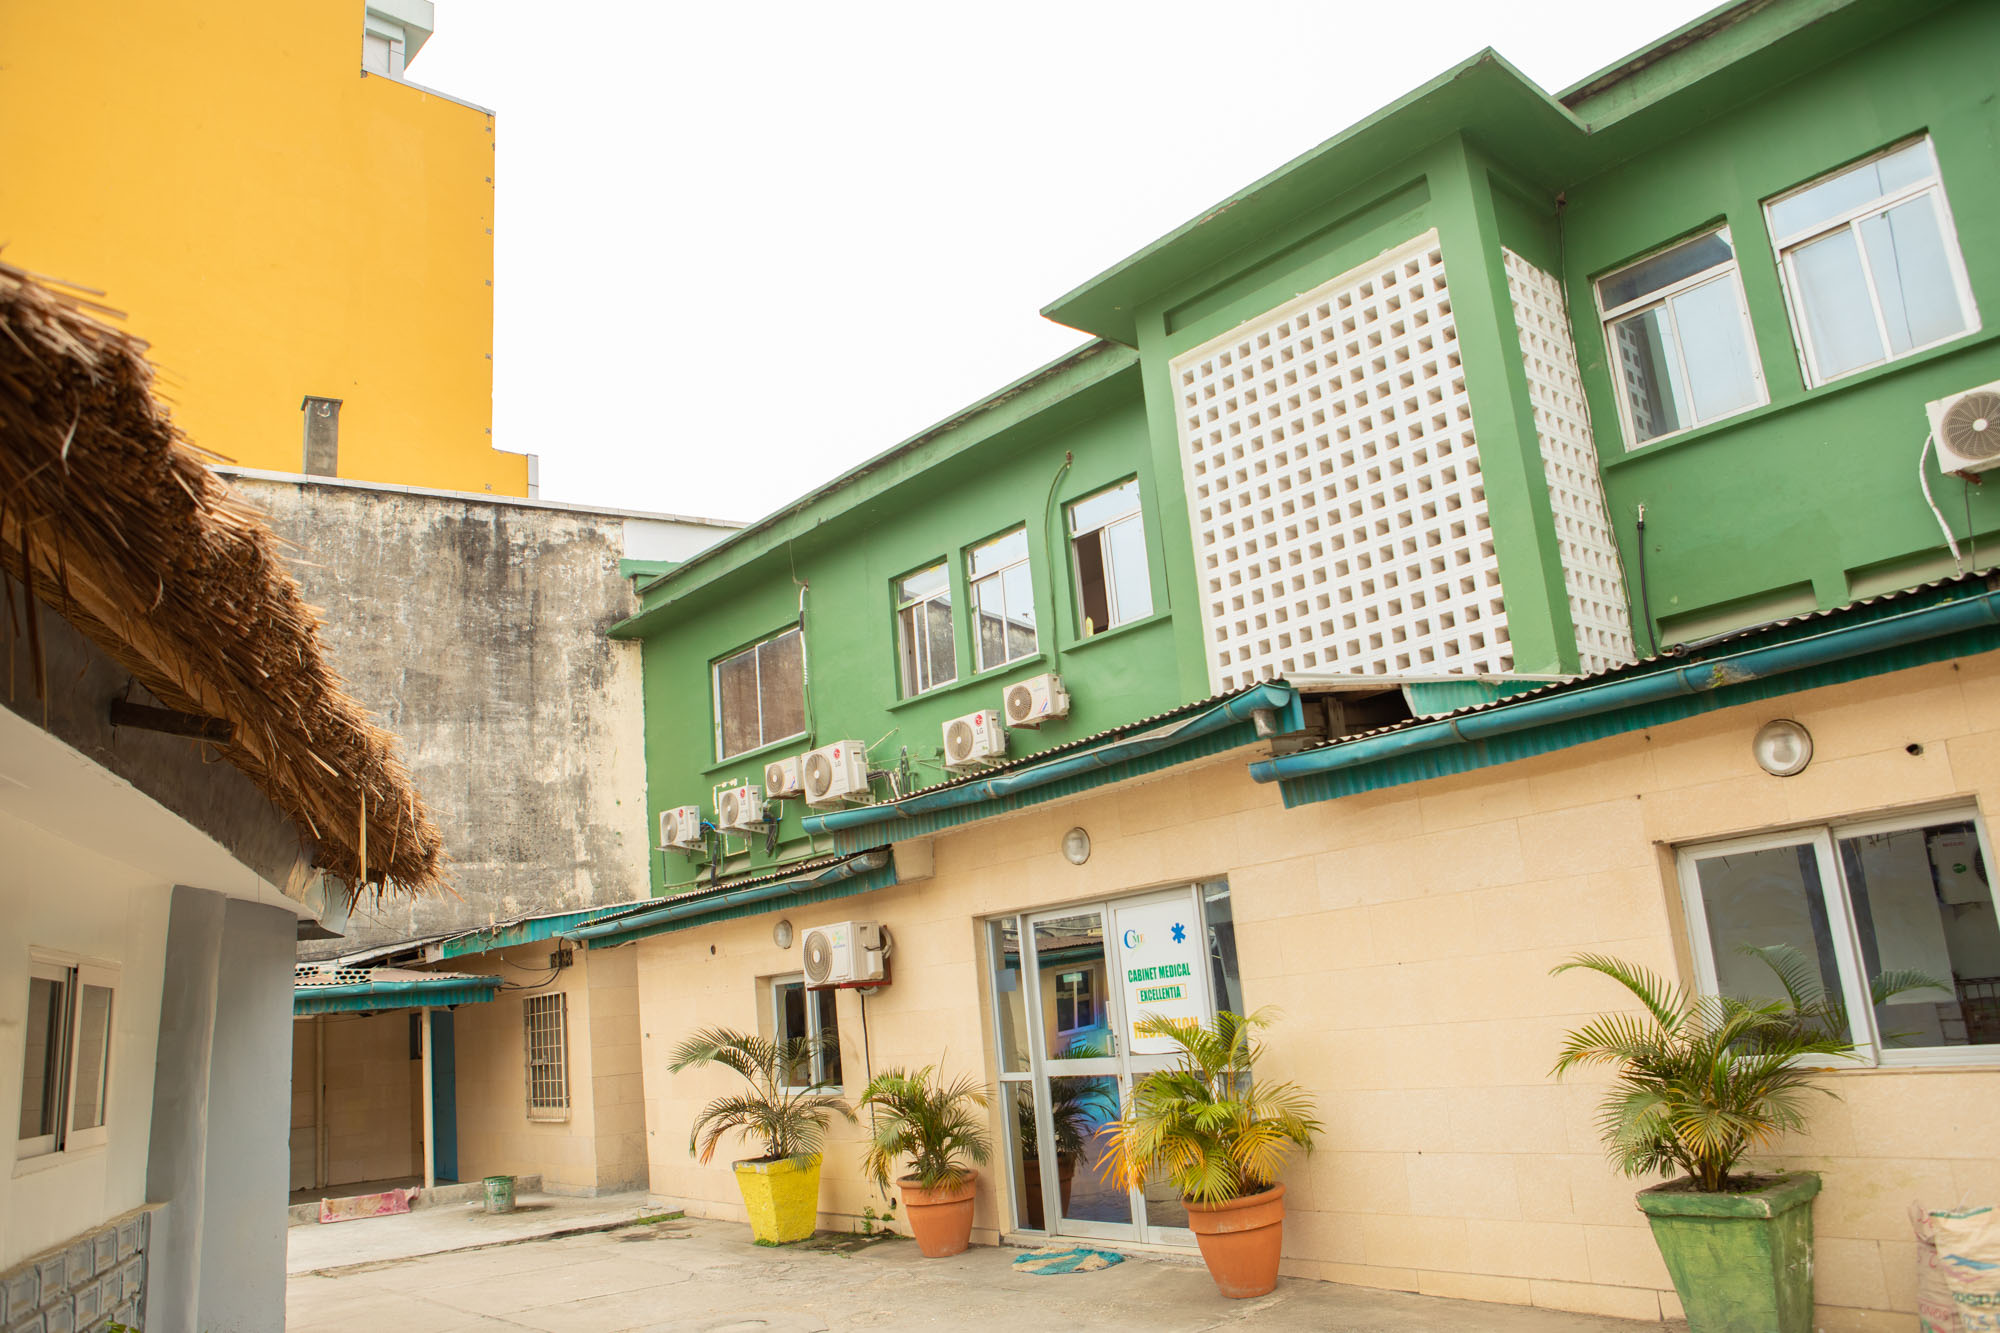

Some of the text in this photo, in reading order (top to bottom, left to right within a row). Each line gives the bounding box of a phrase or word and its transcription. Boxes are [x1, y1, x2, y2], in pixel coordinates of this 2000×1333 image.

[1128, 962, 1191, 983] CABINET MEDICAL
[1140, 986, 1181, 1002] EXCELLENTIA
